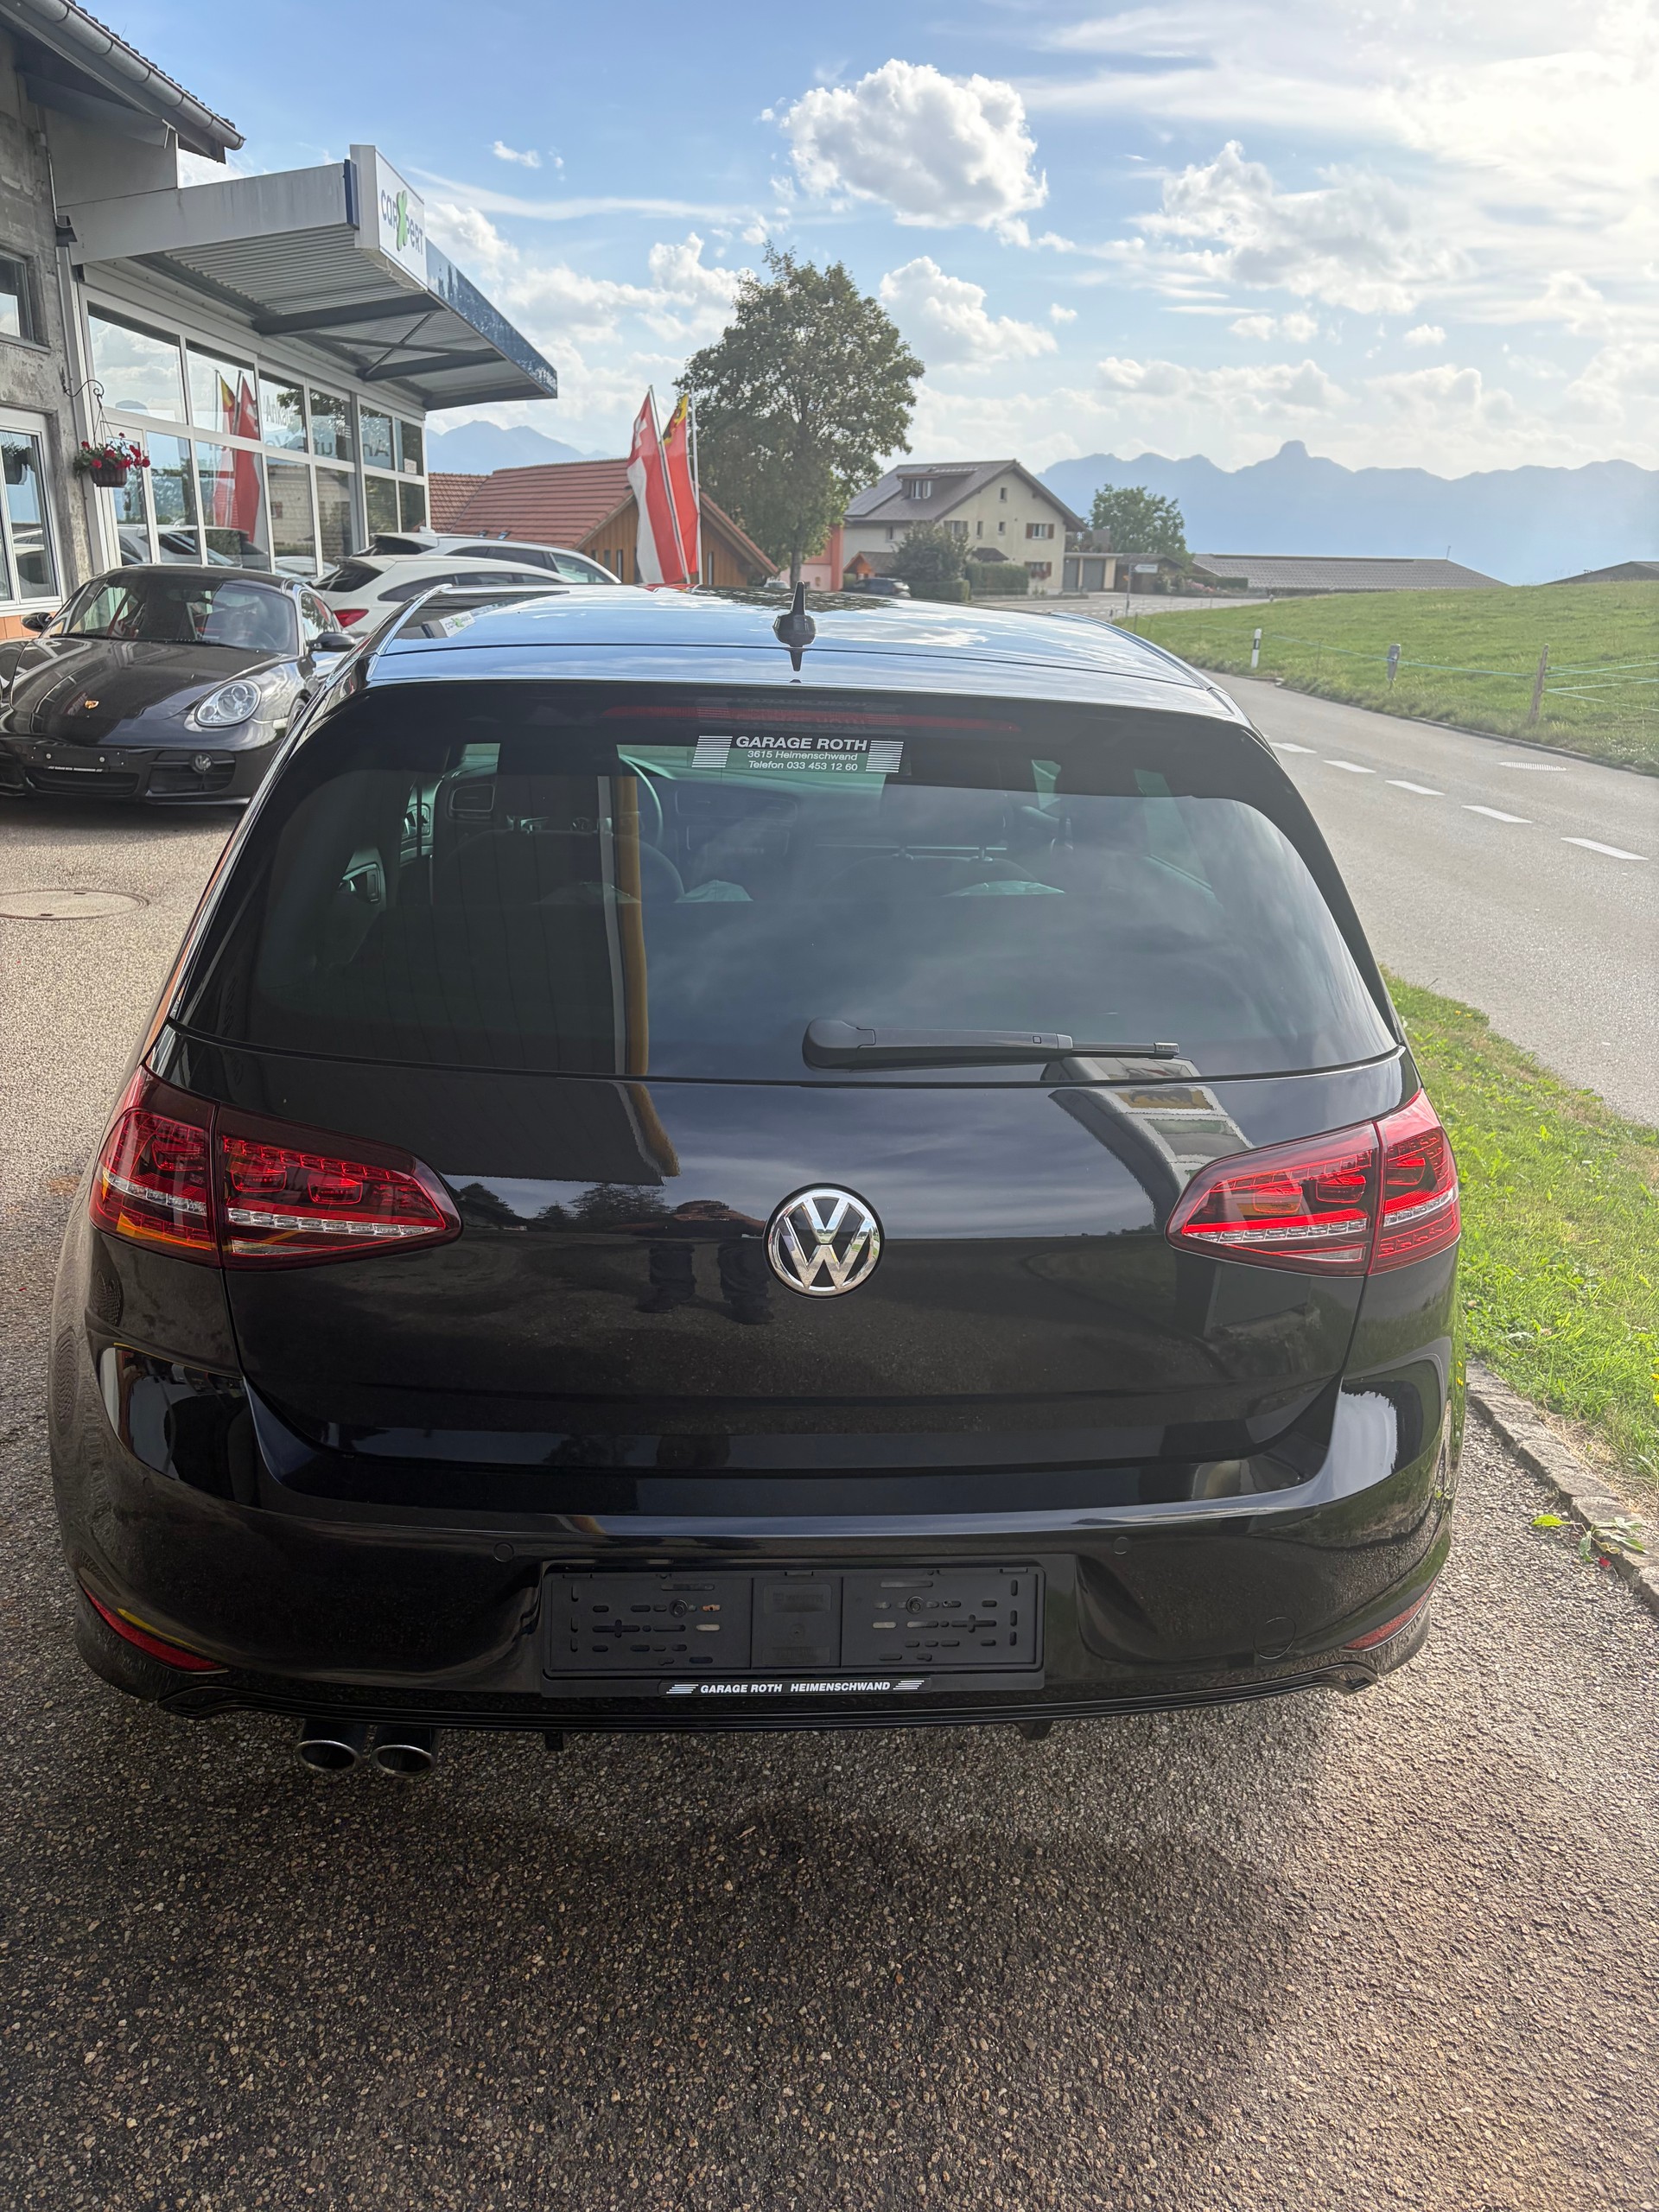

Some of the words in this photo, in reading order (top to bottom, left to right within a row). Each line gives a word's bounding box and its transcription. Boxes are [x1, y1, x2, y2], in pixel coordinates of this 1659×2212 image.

[735, 735, 813, 750] GARAGE
[817, 737, 868, 751] ROTH
[747, 750, 772, 759] 3615
[775, 750, 858, 761] Heimenschwand
[748, 760, 784, 769] Telefon
[786, 761, 807, 770] 033
[808, 761, 827, 771] 453
[831, 762, 842, 771] 12
[845, 762, 858, 772] 60
[700, 1684, 748, 1694] GARAGE
[750, 1683, 783, 1693] ROTH
[790, 1681, 891, 1692] HEIMENSCHWAND
